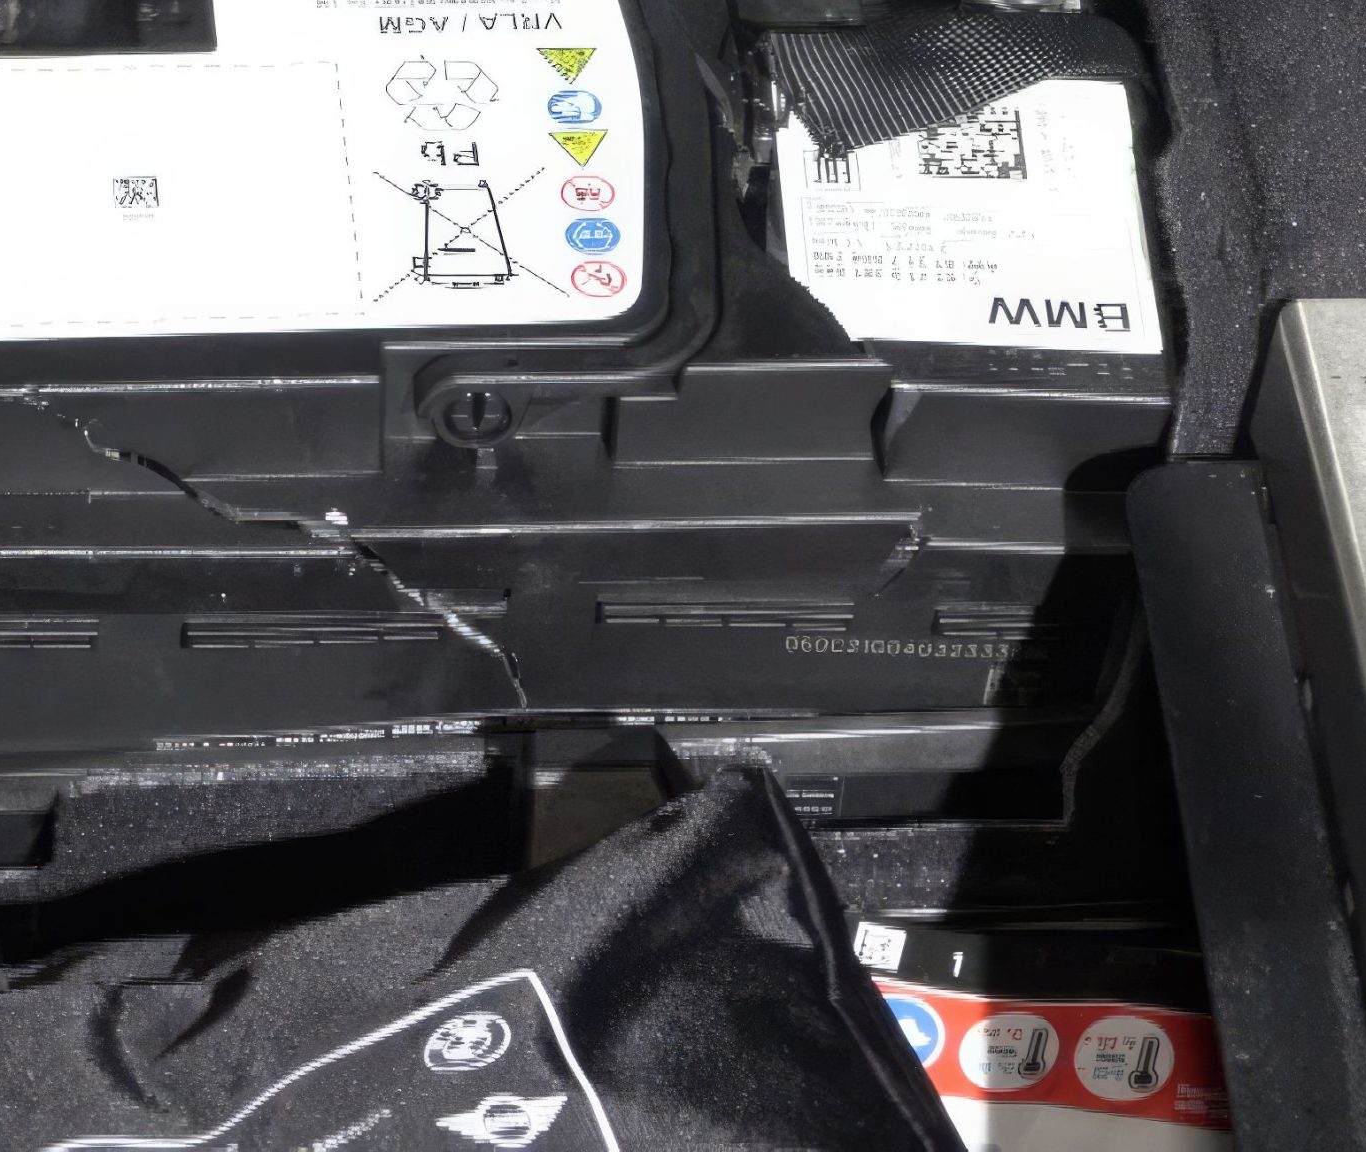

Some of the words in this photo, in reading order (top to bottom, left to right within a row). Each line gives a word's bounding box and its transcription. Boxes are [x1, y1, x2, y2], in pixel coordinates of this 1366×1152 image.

[379, 15, 449, 34] AGM
[479, 12, 563, 30] VRLA
[420, 141, 480, 166] Pb
[988, 296, 1132, 332] BMW
[952, 951, 964, 978] 1
